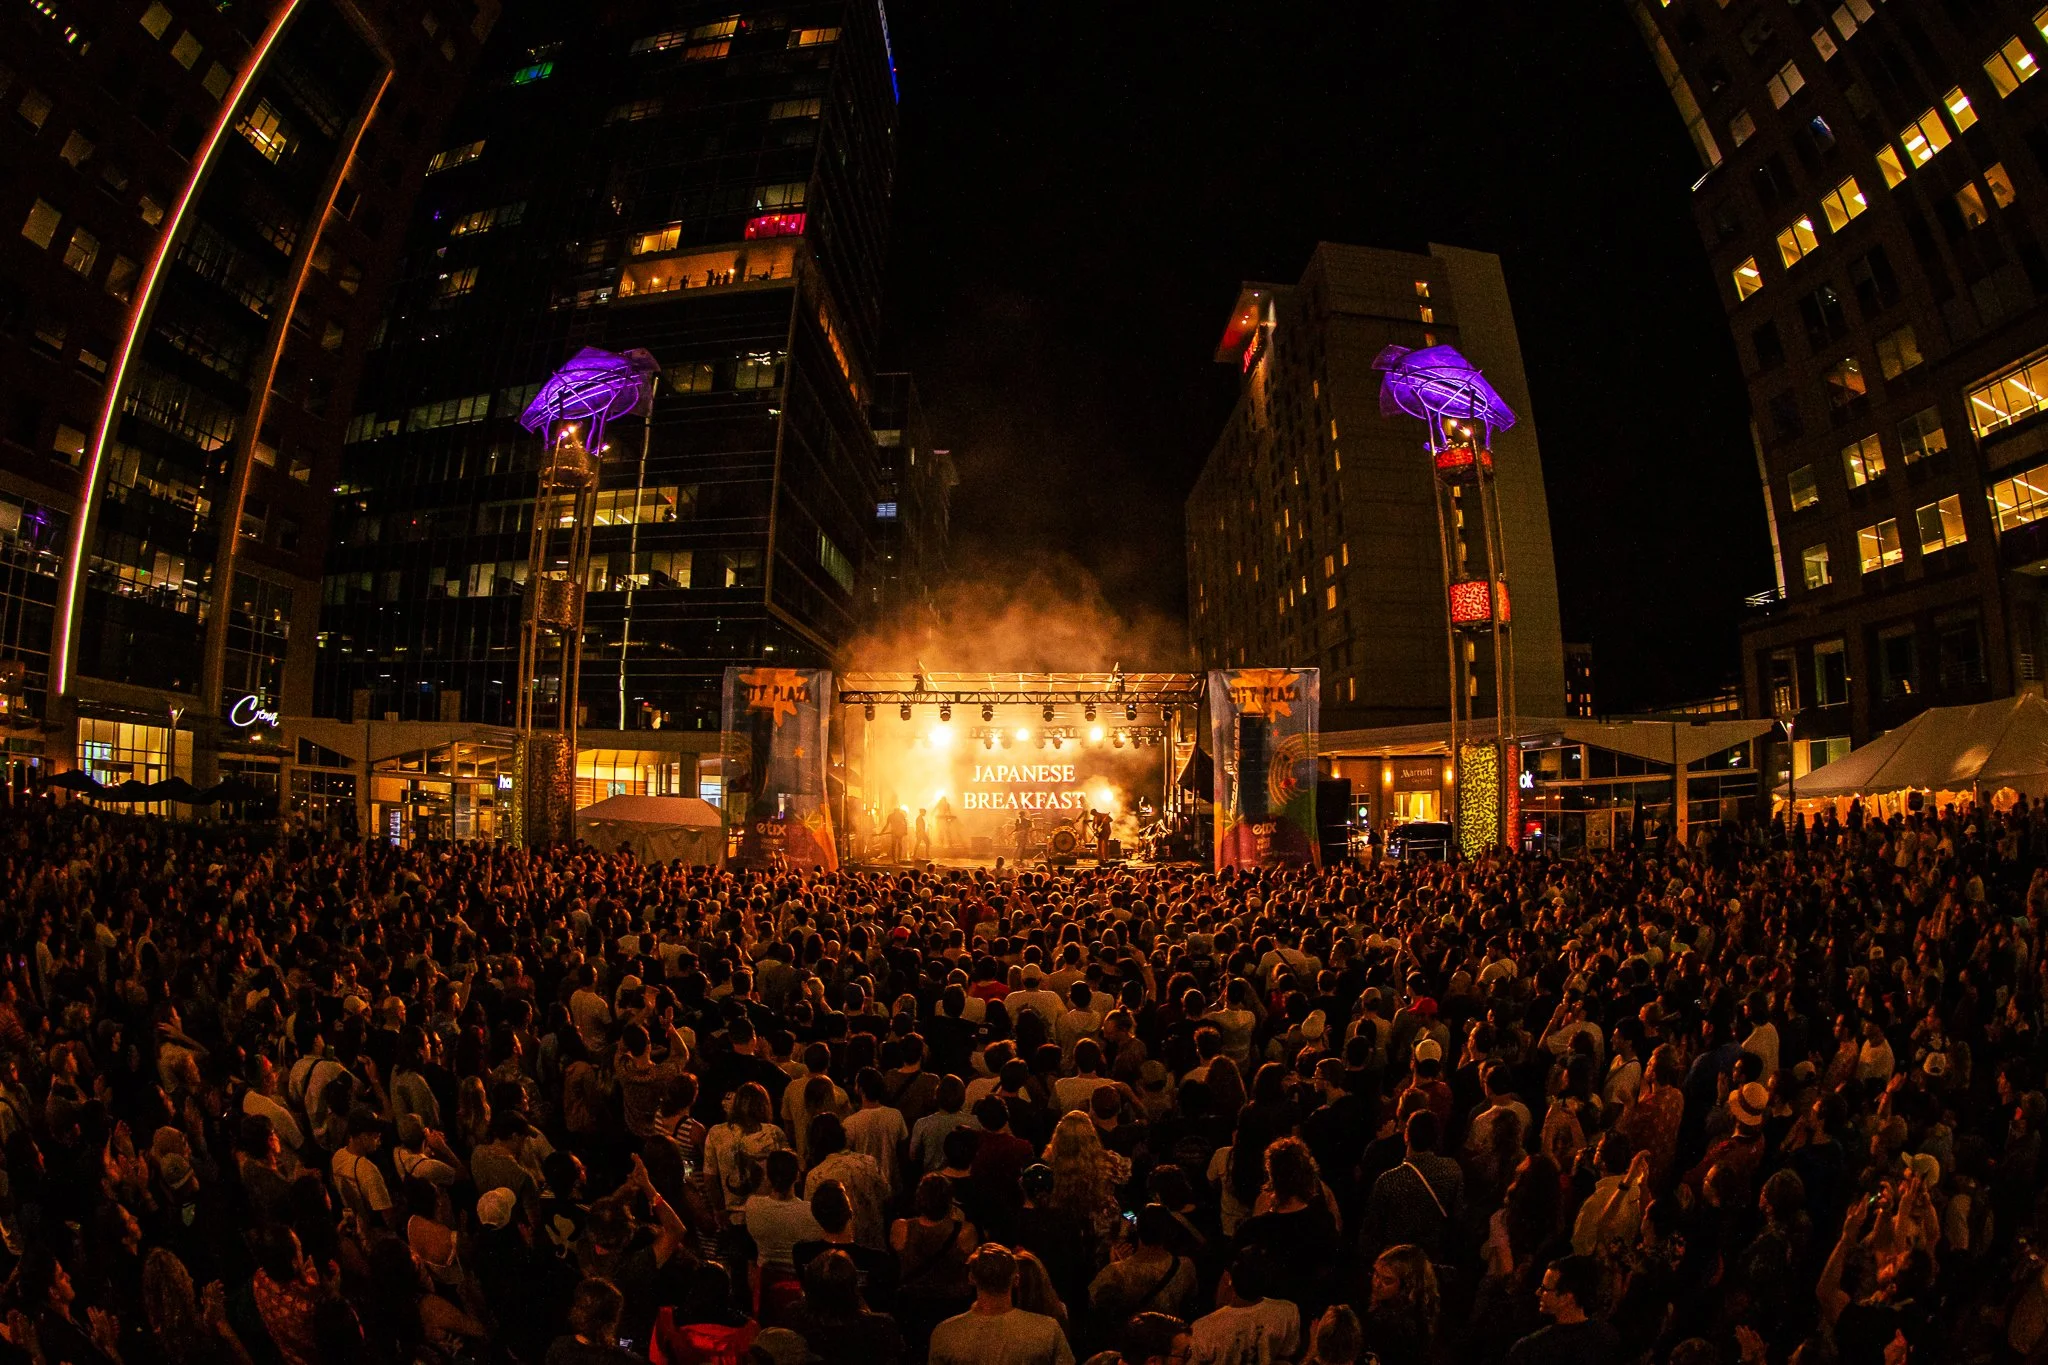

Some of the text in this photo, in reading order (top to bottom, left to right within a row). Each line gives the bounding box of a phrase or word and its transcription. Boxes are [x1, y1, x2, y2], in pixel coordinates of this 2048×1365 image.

[773, 685, 812, 703] PLAZA
[1228, 686, 1302, 704] CITY PLAZA
[972, 764, 1076, 783] JAPANESE
[1400, 768, 1433, 778] Marriott
[963, 791, 1087, 810] BREAKFAST
